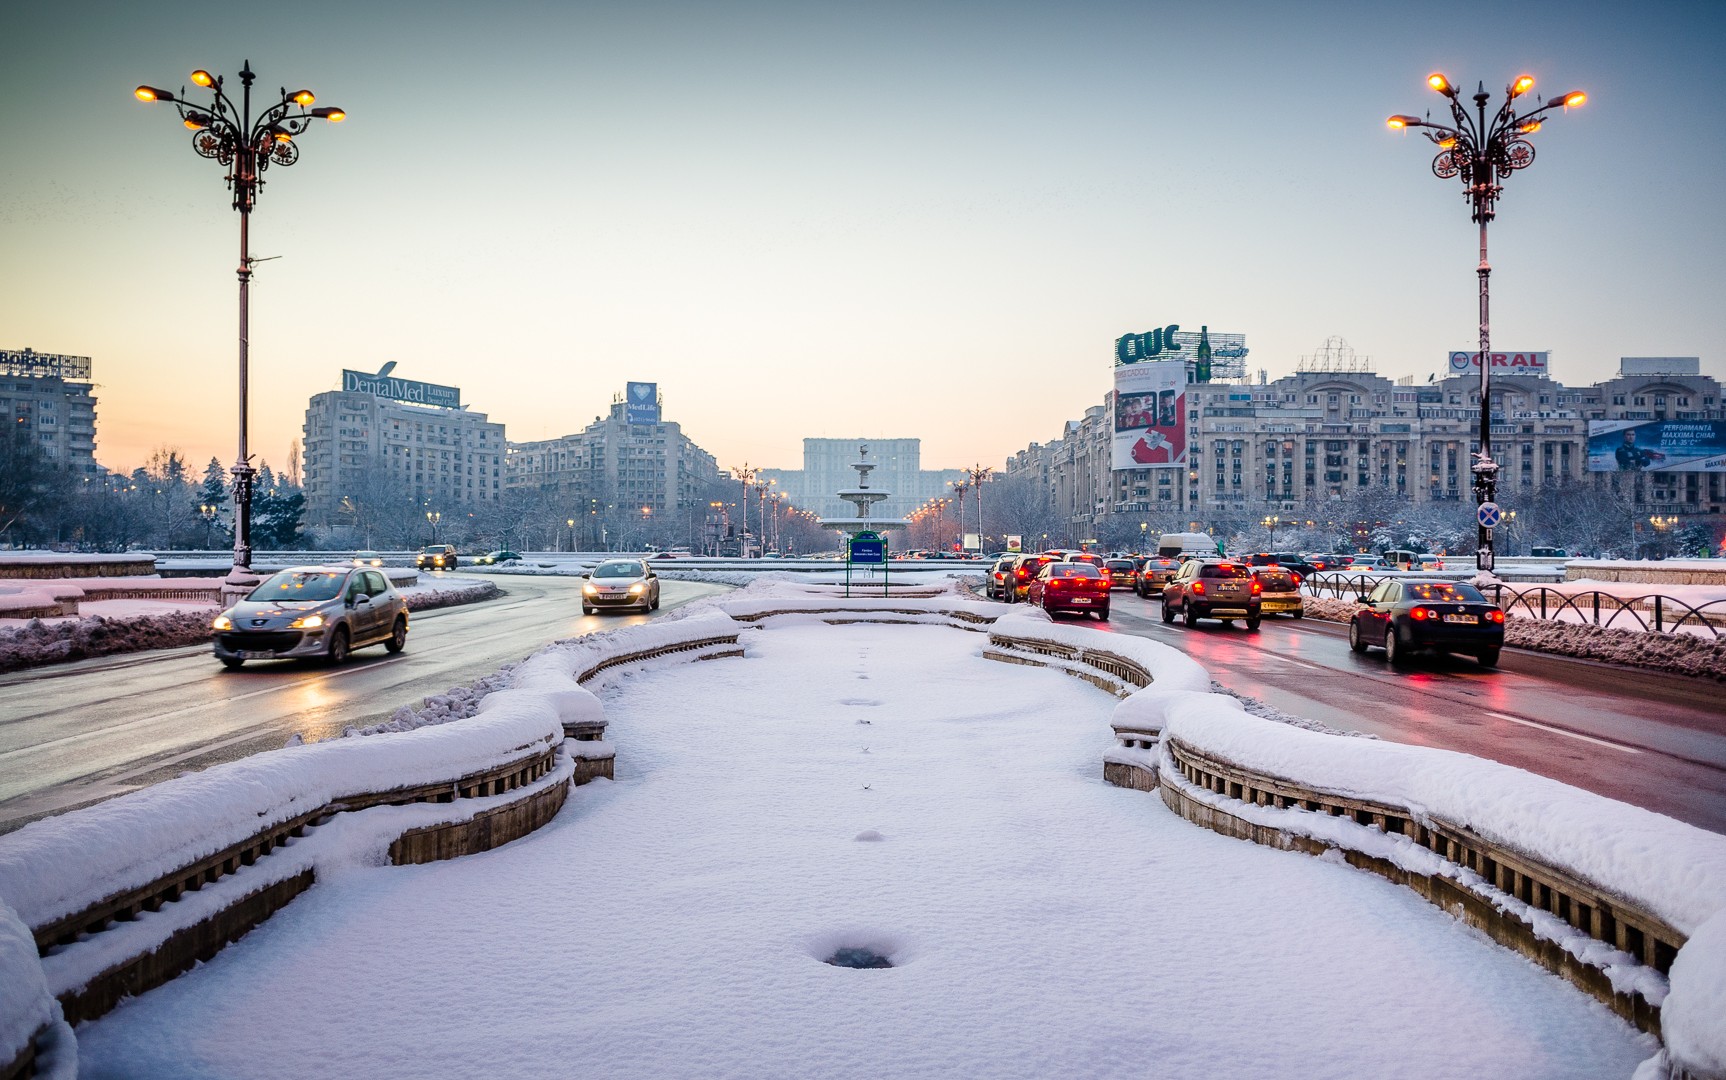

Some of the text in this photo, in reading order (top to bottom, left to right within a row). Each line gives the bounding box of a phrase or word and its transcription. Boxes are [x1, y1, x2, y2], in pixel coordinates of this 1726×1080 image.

[345, 372, 455, 402] DentalMed Luxury
[627, 403, 657, 411] MedLife
